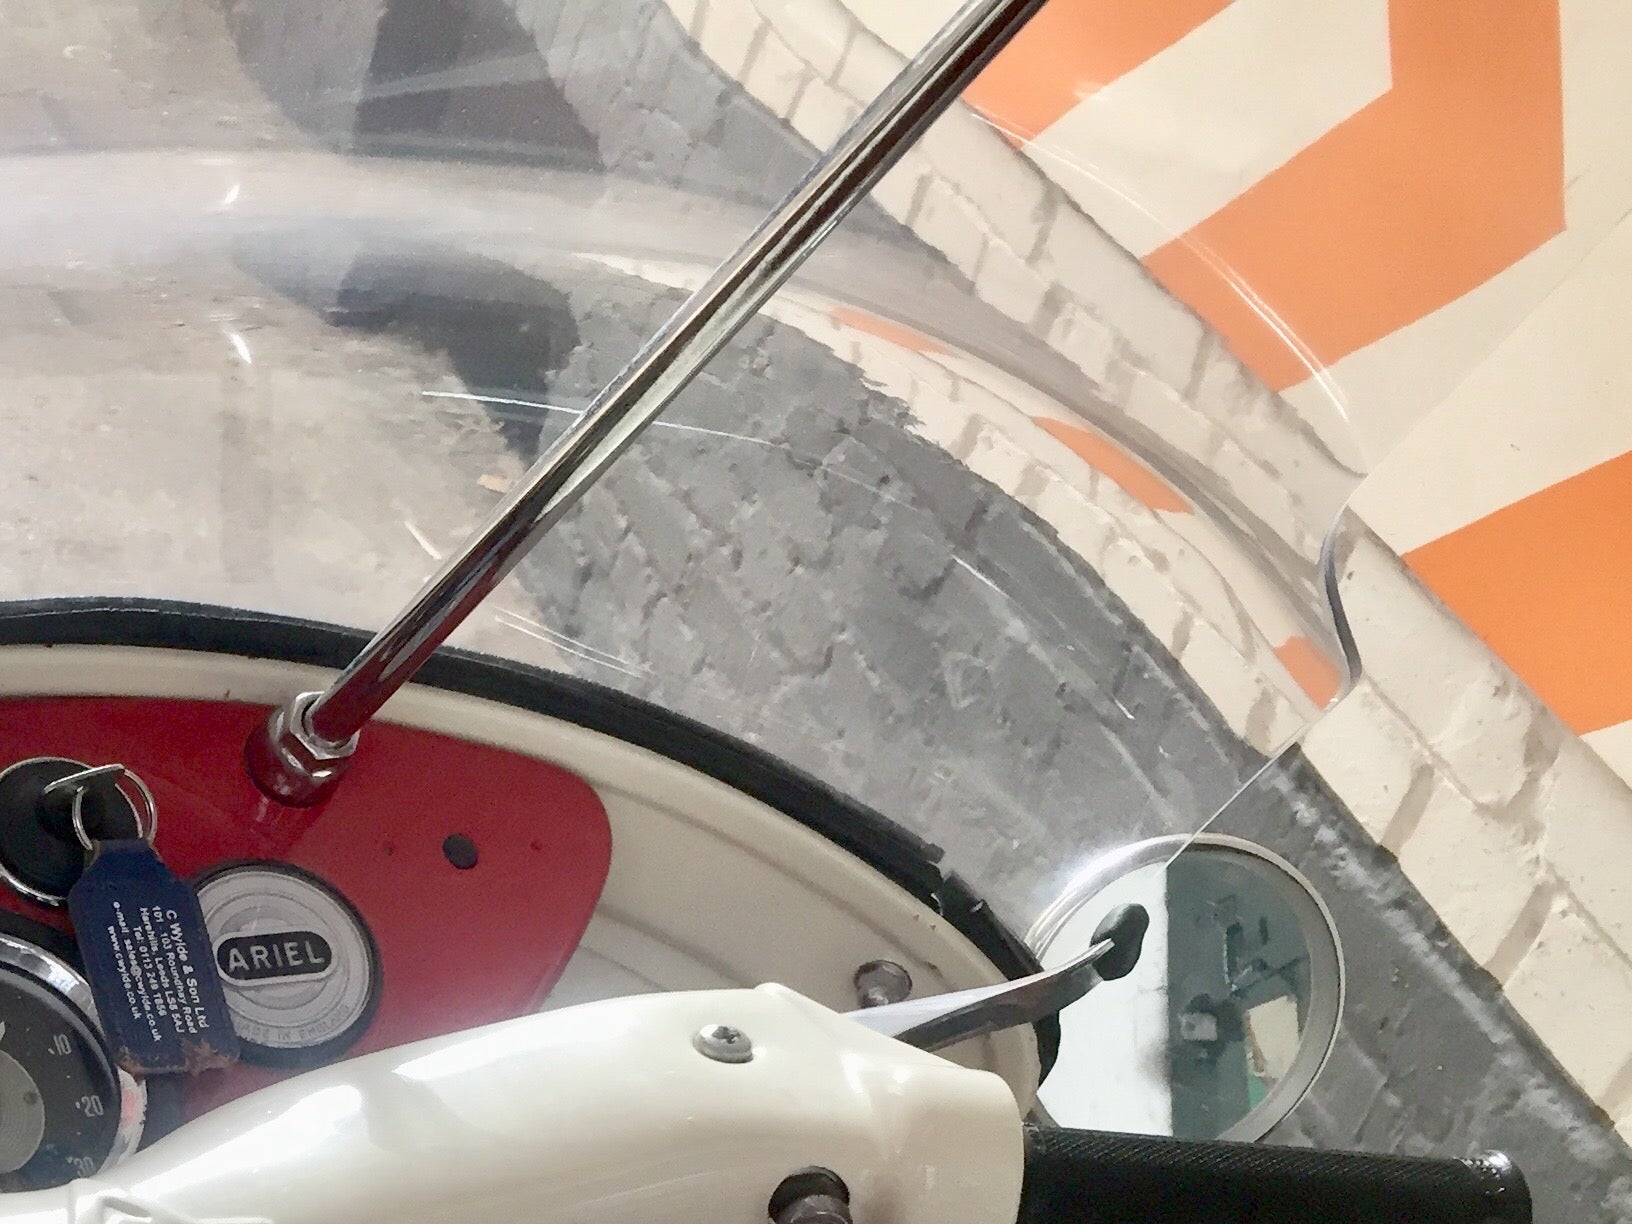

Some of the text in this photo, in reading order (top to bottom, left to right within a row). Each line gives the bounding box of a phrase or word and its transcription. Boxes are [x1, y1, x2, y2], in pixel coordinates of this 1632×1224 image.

[152, 905, 164, 923] 101
[159, 932, 172, 950] 103
[138, 945, 152, 970] 0113
[165, 908, 209, 1029] C Wylde & Son Ltd
[228, 940, 325, 972] ARIEL
[106, 925, 142, 1020] www.cwylde.co.uk
[165, 951, 188, 1005] Roundhay
[154, 957, 170, 989] Leeds
[171, 1013, 185, 1033] 5AJ
[182, 1006, 197, 1034] Road
[53, 1033, 72, 1056] 10
[81, 1095, 104, 1118] 20
[73, 1156, 95, 1178] 30
